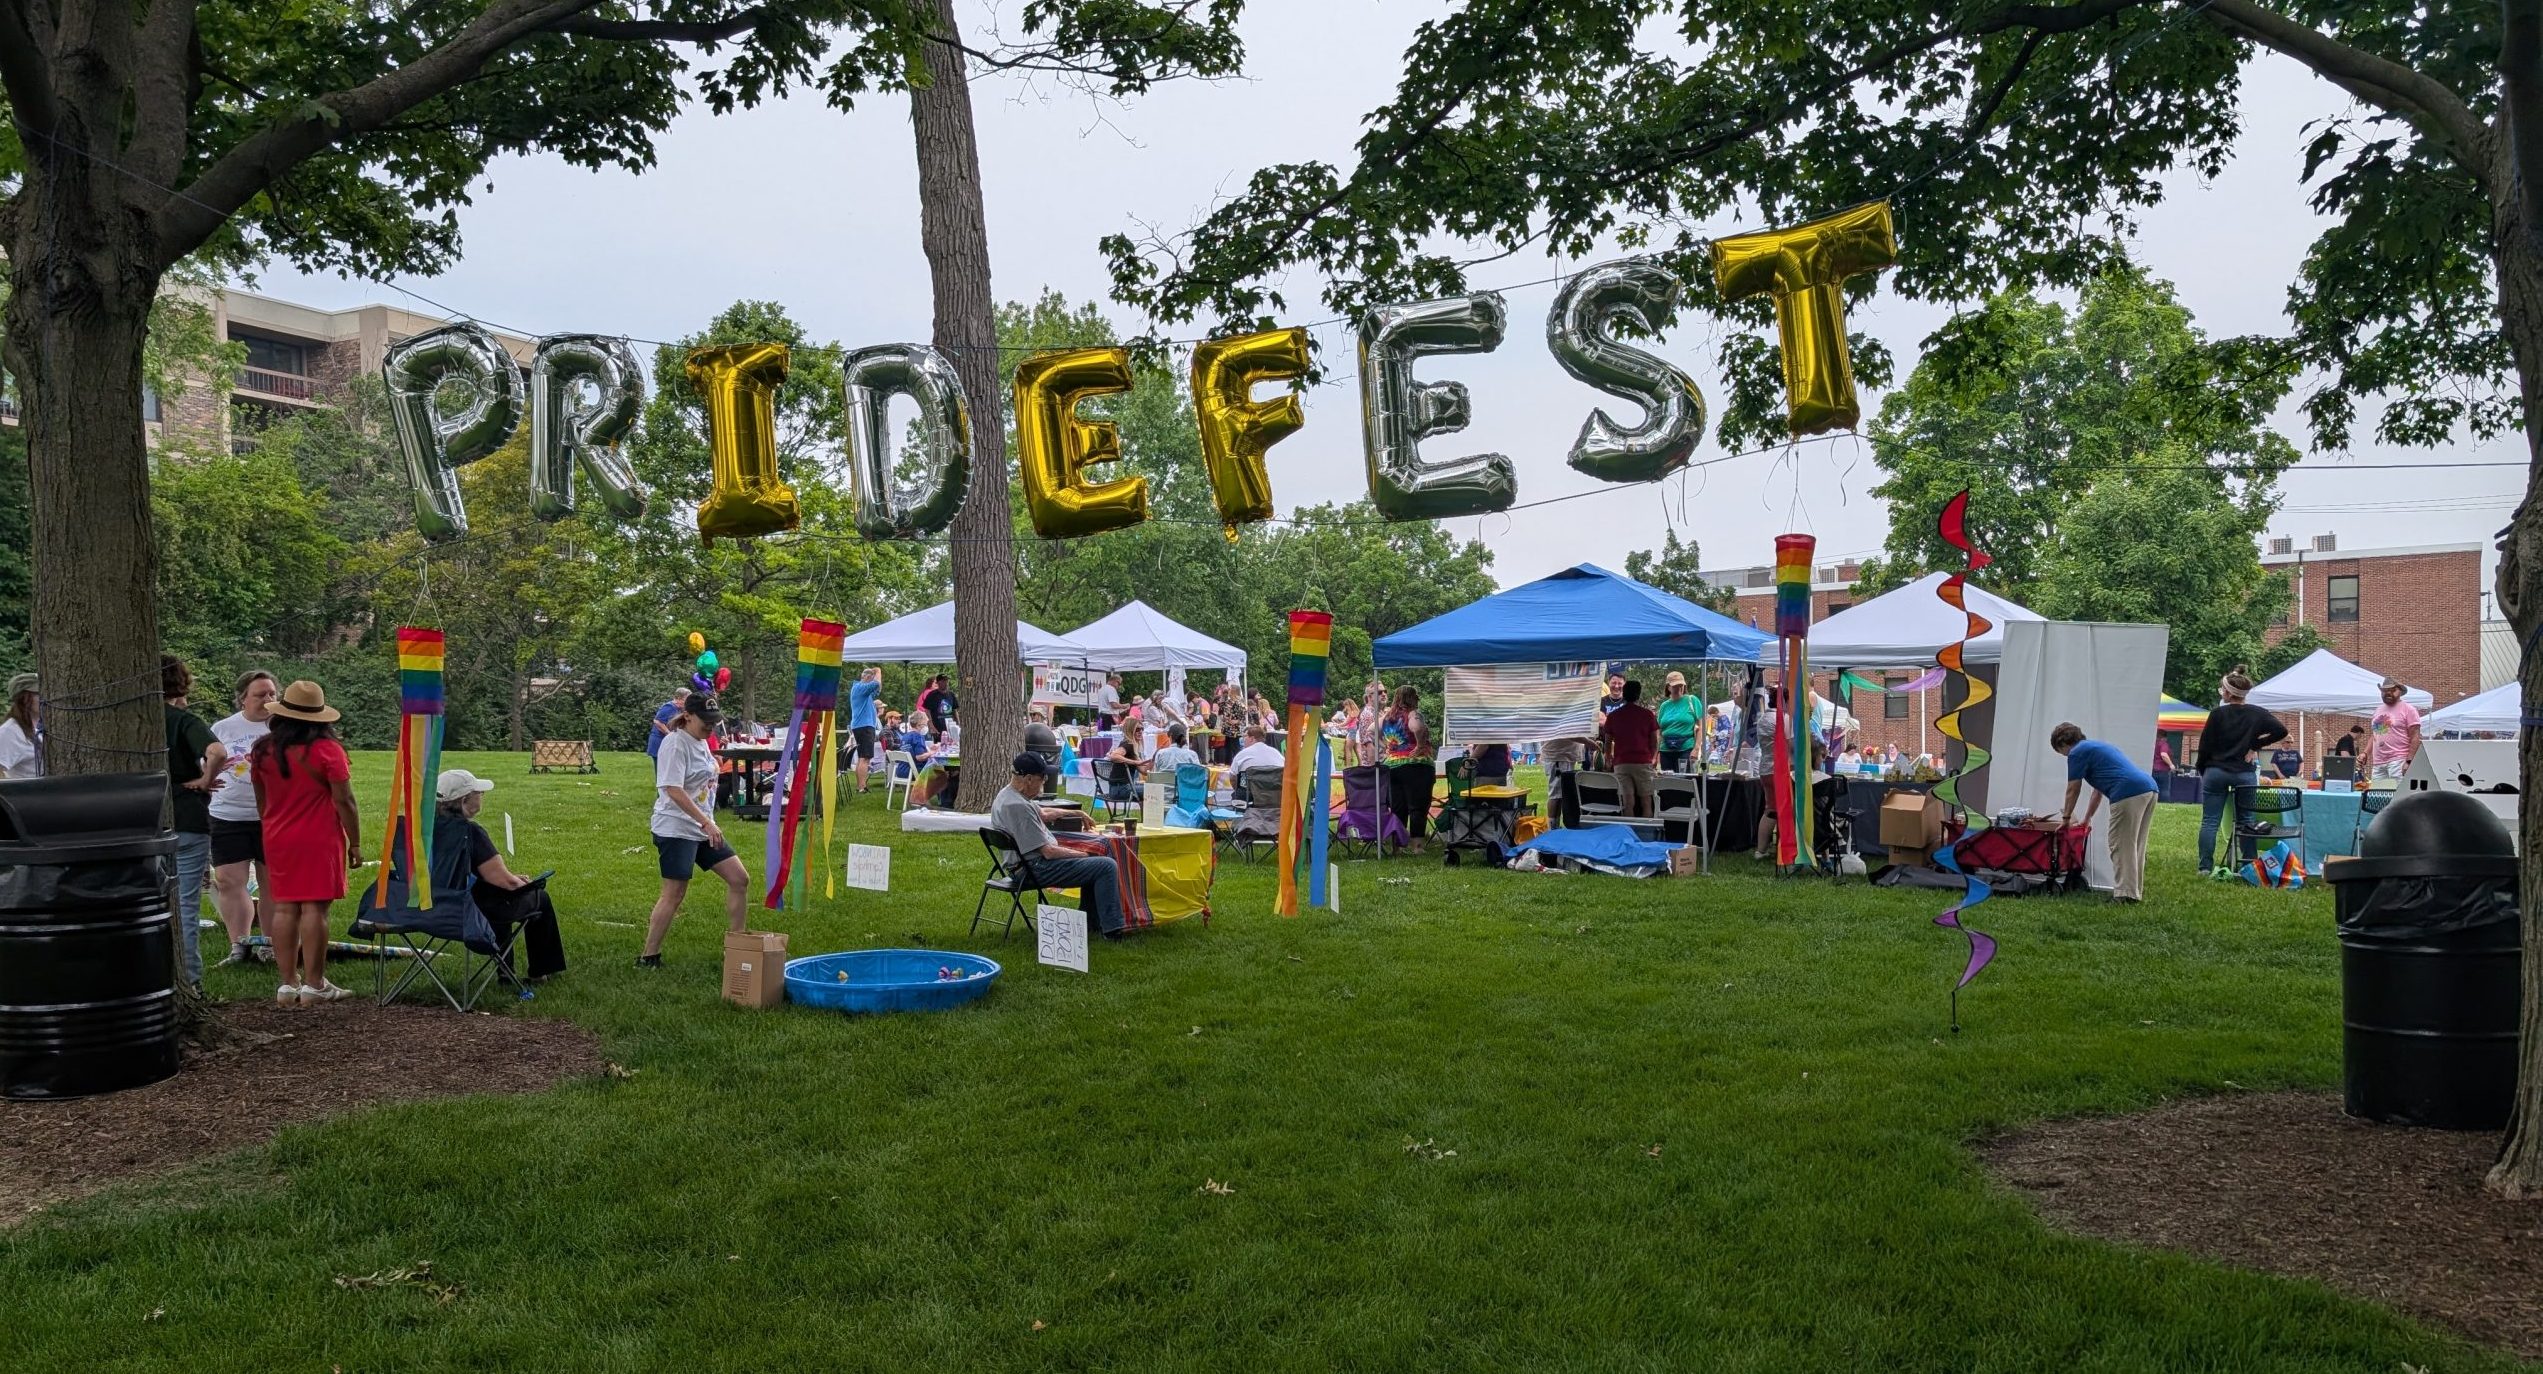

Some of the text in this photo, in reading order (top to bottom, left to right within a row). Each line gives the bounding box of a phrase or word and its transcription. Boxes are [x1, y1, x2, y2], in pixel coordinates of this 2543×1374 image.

[1060, 676, 1087, 695] QDG
[1040, 908, 1056, 960] DUCK
[1056, 909, 1072, 963] POND
